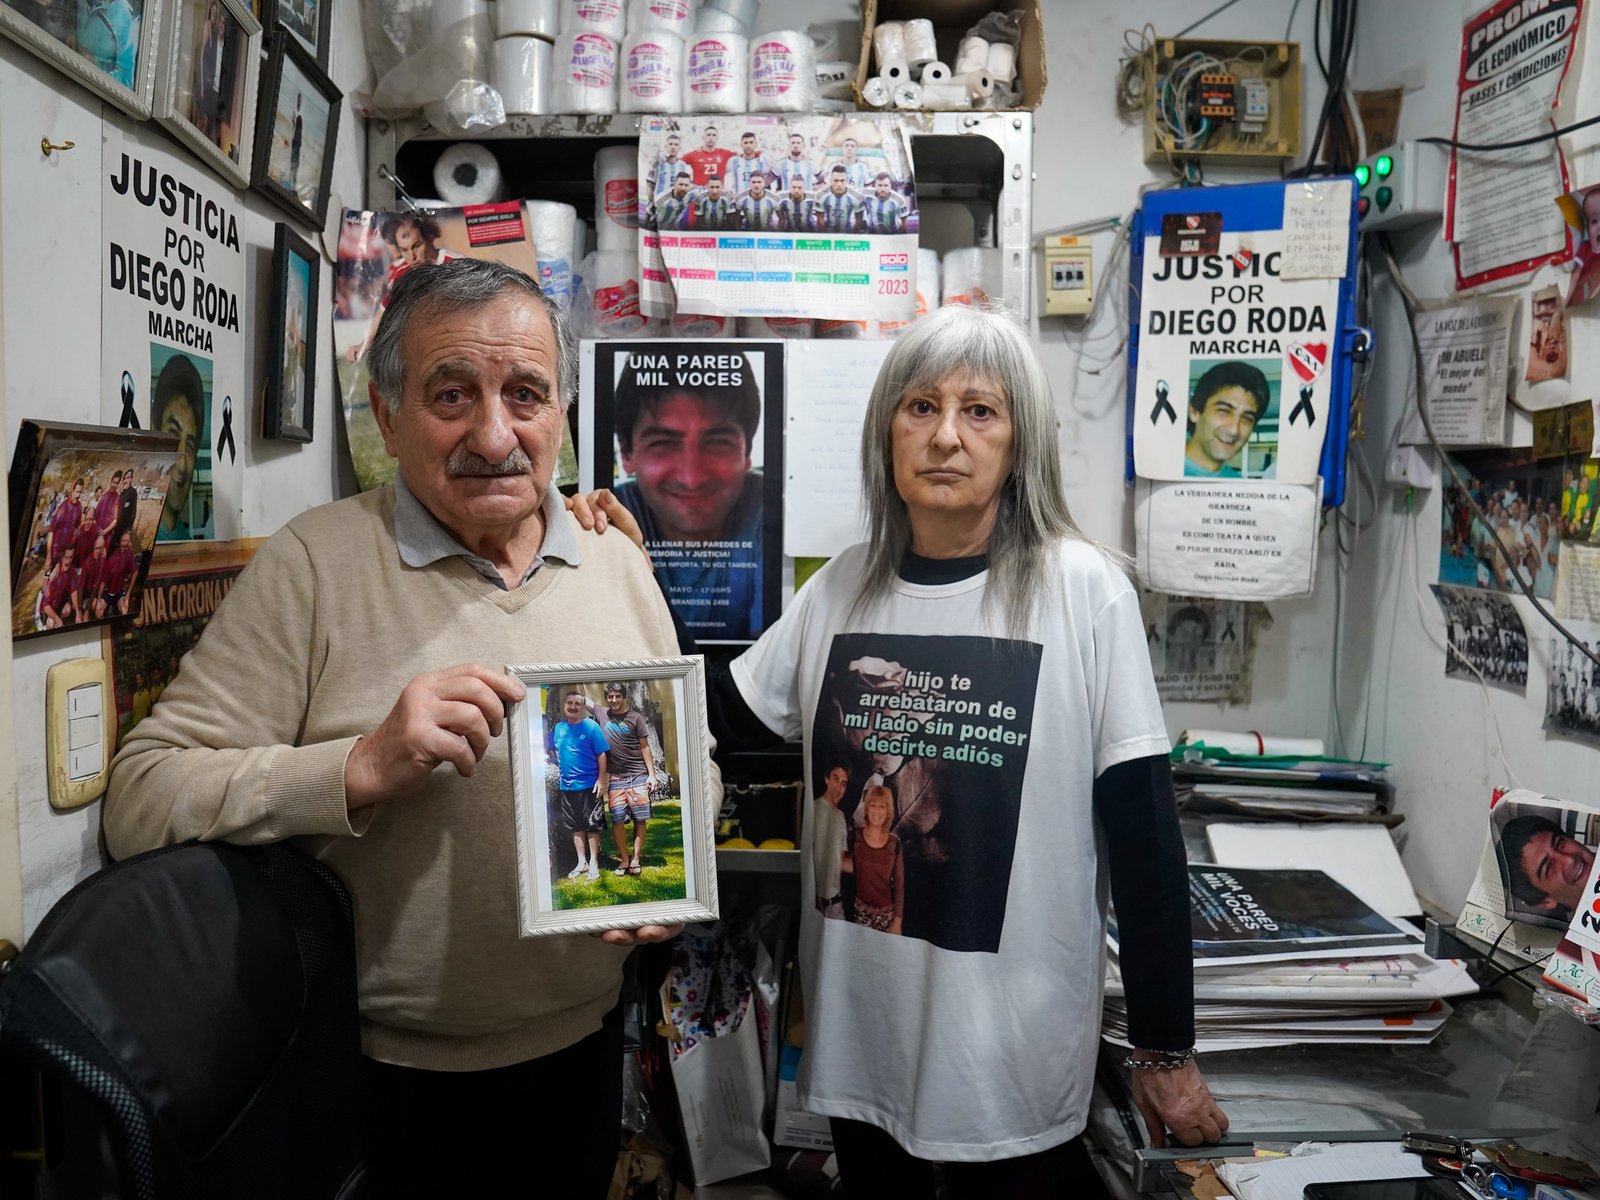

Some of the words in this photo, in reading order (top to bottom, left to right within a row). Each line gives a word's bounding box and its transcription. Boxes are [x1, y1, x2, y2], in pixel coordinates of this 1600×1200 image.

[1470, 0, 1560, 53] PROM
[1478, 58, 1489, 78] EL
[1491, 14, 1566, 72] ECONÓMICO
[1469, 83, 1497, 106] BASES
[1498, 78, 1505, 92] Y
[1505, 46, 1567, 89] CONDICIONES
[110, 152, 240, 254] JUSTICIA
[164, 226, 204, 273] POR
[110, 242, 186, 312] DIEGO
[192, 276, 239, 333] RODA
[878, 280, 909, 294] 2023
[1210, 285, 1264, 305] POR
[148, 310, 213, 354] MARCHA
[1148, 308, 1237, 336] DIEGO
[1248, 306, 1328, 334] RODA
[1189, 339, 1282, 355] MARCHA
[630, 355, 669, 370] UNA
[676, 355, 743, 369] PARED
[636, 372, 669, 386] MIL
[676, 372, 743, 386] VOCES
[1448, 368, 1471, 380] mejor
[1186, 490, 1232, 498] VERDADERA
[1236, 492, 1264, 500] MEDIDA
[1208, 504, 1252, 512] GRANDEZA
[1225, 519, 1257, 527] HOMBRE
[1216, 532, 1242, 540] TRATA
[1252, 534, 1276, 542] QUIEN
[1213, 546, 1269, 557] BENEFICIARLO
[1271, 550, 1282, 558] EN
[1194, 574, 1212, 582] Diego
[1240, 576, 1259, 584] Roda
[671, 598, 712, 606] BRANDSEN
[904, 671, 944, 693] hijo
[950, 673, 972, 692] te
[859, 693, 981, 716] arrebataron
[988, 700, 1016, 721] de
[844, 712, 869, 730] mi
[874, 713, 919, 734] lado
[924, 718, 954, 736] sin
[959, 722, 1028, 747] poder
[864, 735, 937, 758] decirte
[942, 742, 1004, 768] adiós
[1200, 872, 1224, 890] MIL
[1220, 892, 1261, 930] VOCES
[1216, 872, 1244, 892] UNA
[1236, 894, 1280, 932] PARED
